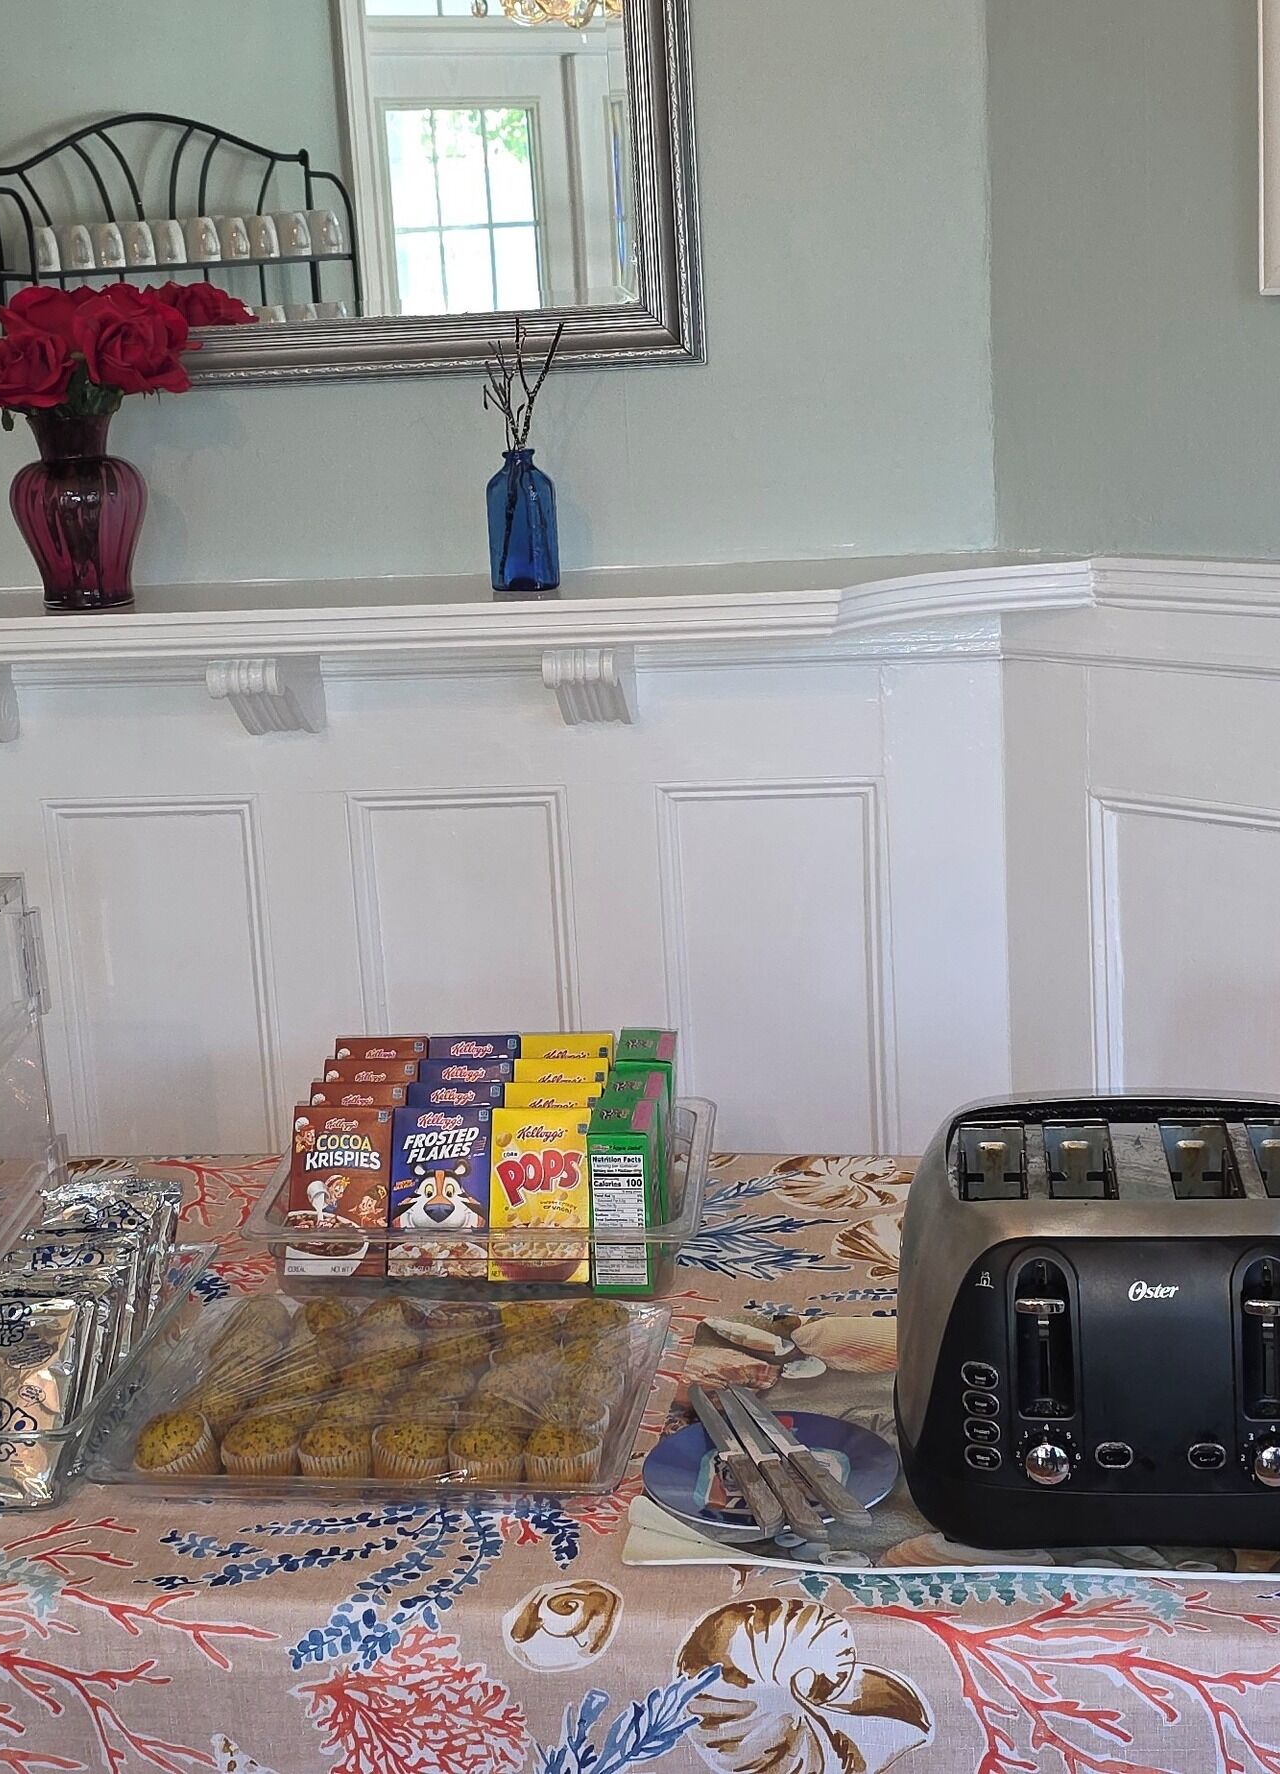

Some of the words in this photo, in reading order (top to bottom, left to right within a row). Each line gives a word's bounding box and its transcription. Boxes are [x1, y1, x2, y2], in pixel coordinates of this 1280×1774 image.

[450, 1041, 494, 1058] Kellogg's
[441, 1065, 486, 1082] Kellogg's
[430, 1087, 476, 1106] Kellogg's
[325, 1117, 359, 1131] Kellogg's
[417, 1111, 464, 1130] Kellogg's
[316, 1134, 372, 1152] COCOA
[403, 1127, 480, 1151] FROSTED
[516, 1126, 565, 1143] Kellogg's
[305, 1151, 381, 1171] KRISPIES
[406, 1141, 472, 1164] FLAKES
[495, 1149, 583, 1208] POPS
[626, 1178, 642, 1187] 100
[1128, 1280, 1179, 1301] Oster
[1066, 1432, 1072, 1440] 5
[1240, 1454, 1246, 1462] 2
